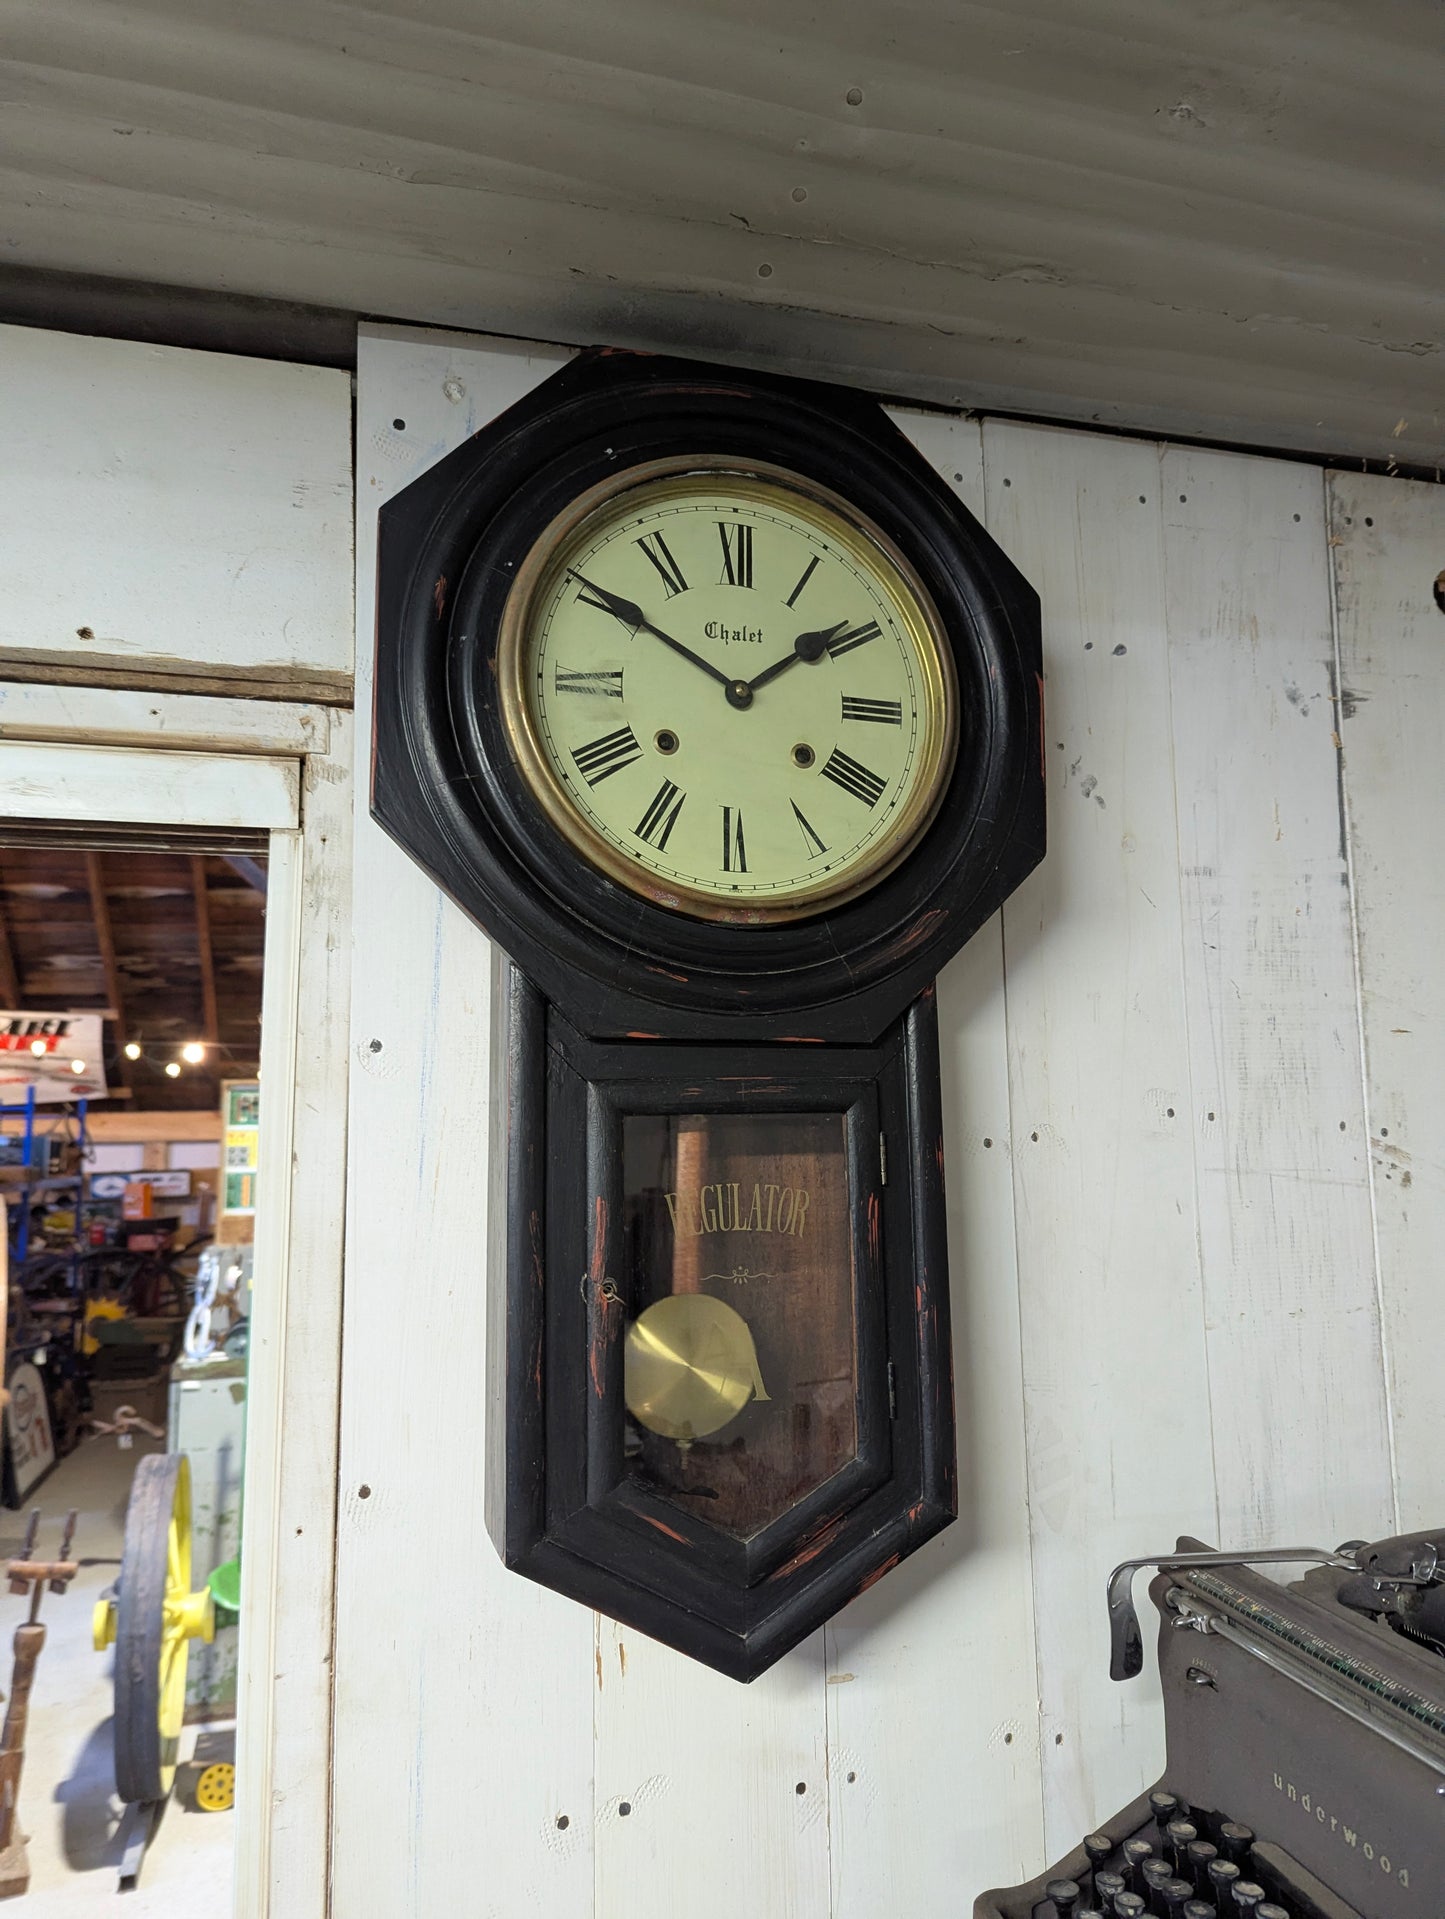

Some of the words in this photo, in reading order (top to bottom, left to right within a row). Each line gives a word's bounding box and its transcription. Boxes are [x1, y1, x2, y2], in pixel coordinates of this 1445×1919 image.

[631, 529, 694, 601] XI
[713, 522, 758, 589] XII
[781, 551, 825, 611] I
[704, 621, 763, 645] Chalet
[826, 615, 885, 664] II
[840, 690, 902, 729] III
[569, 721, 645, 792] VIII
[628, 776, 688, 854] VII
[718, 805, 752, 873] VI
[789, 797, 833, 860] V
[664, 1183, 810, 1238] REGULATOR
[1273, 1772, 1409, 1889] underwood
